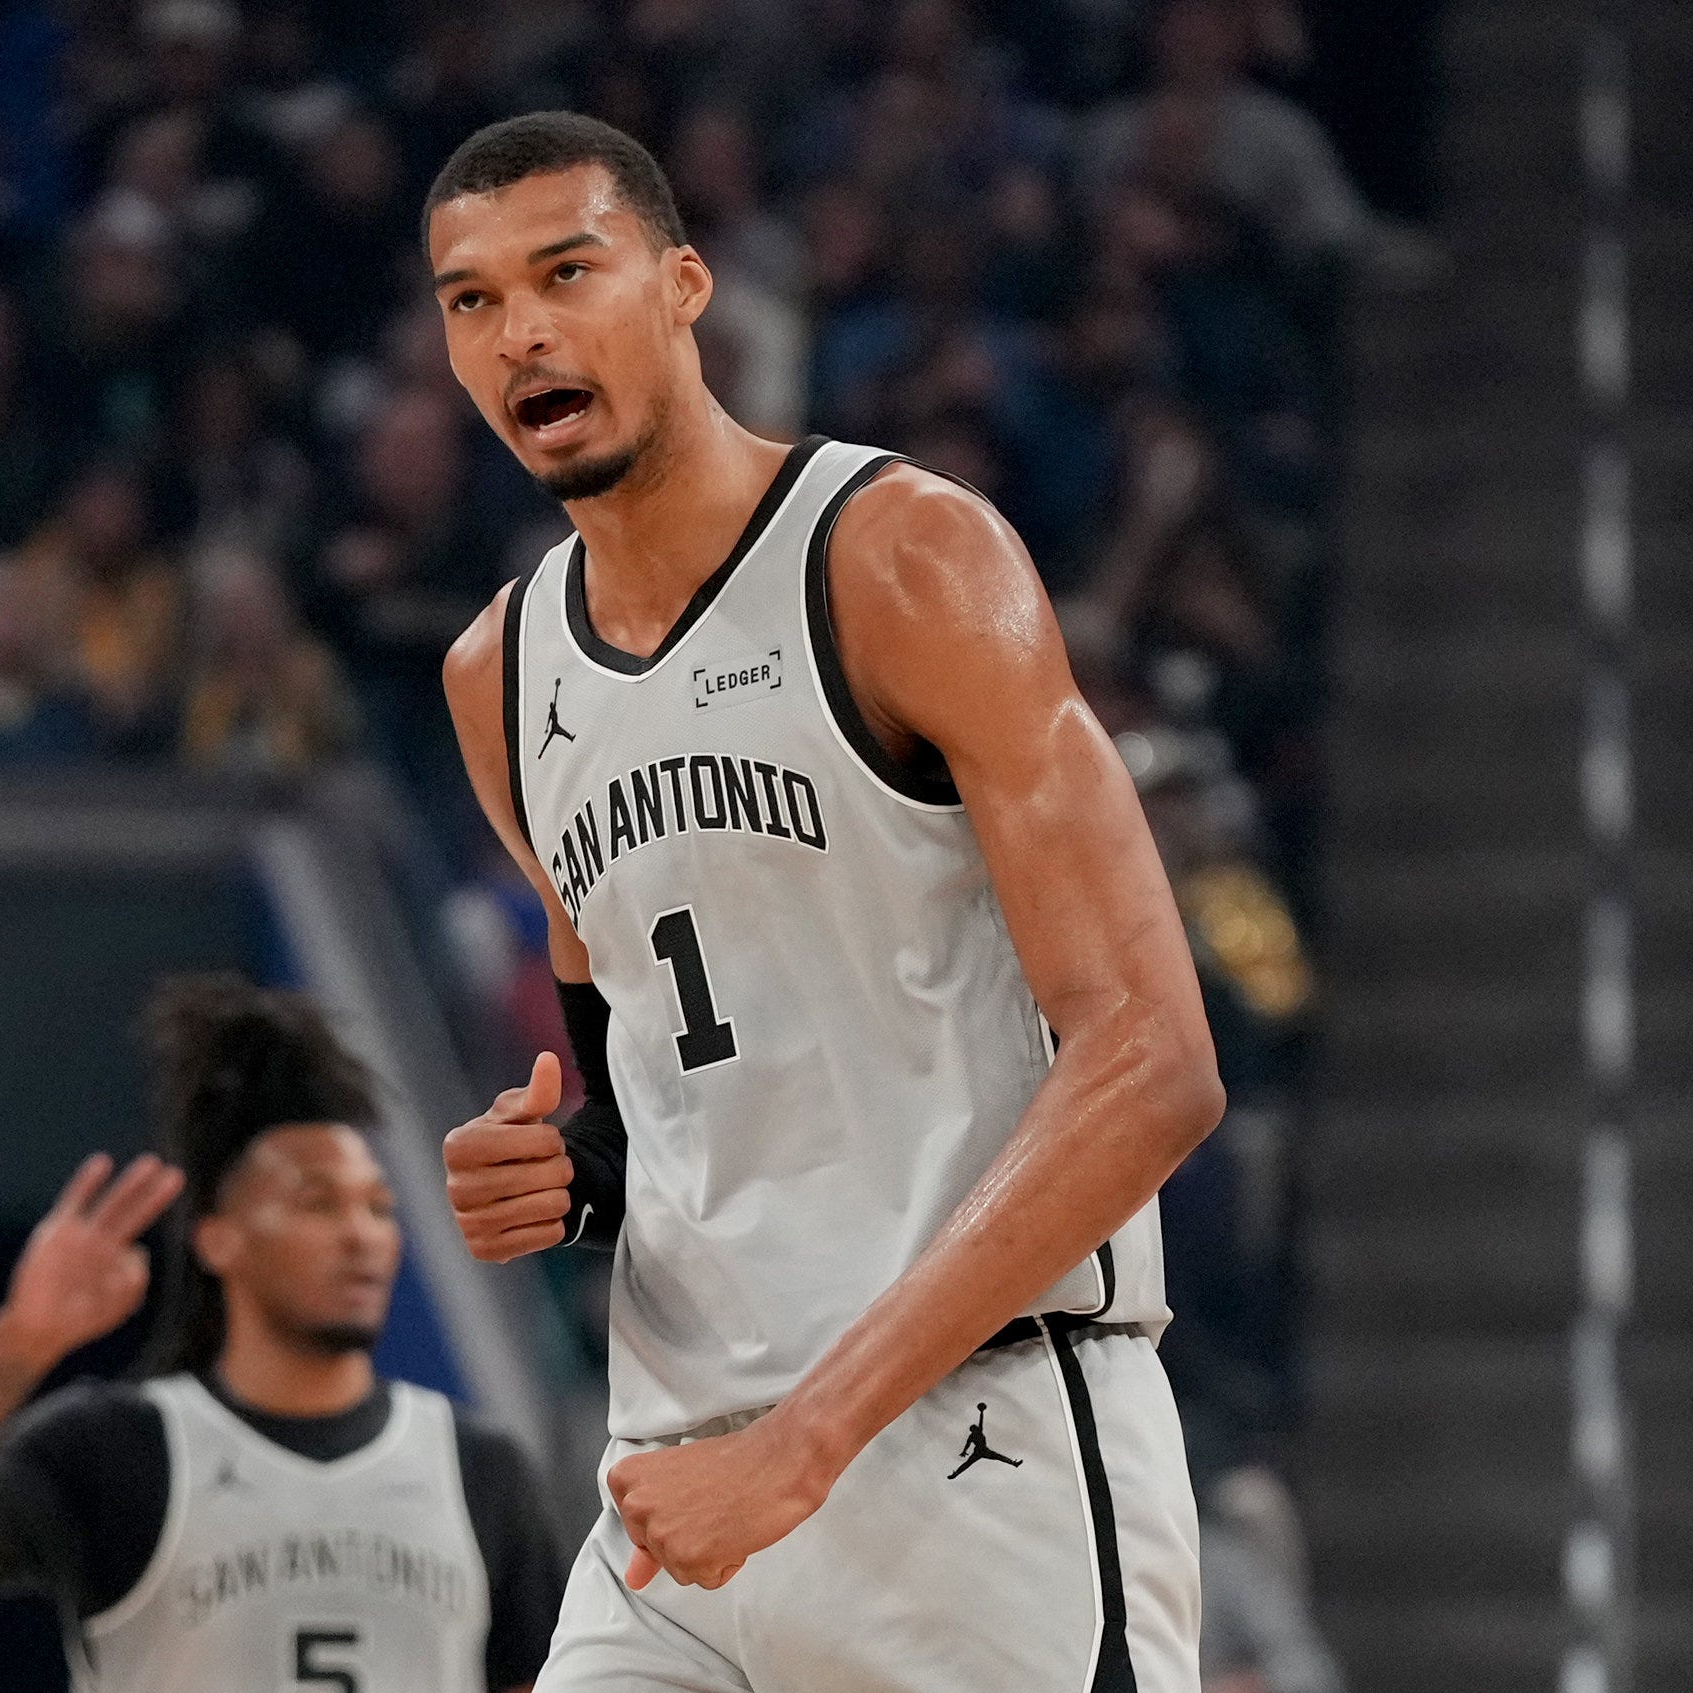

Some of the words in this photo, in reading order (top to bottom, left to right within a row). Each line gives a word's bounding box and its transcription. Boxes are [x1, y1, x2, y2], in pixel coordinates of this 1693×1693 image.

[704, 664, 772, 695] LEDGER
[552, 797, 606, 935] SAN
[608, 753, 830, 866] ANTONIO
[647, 904, 740, 1076] 1
